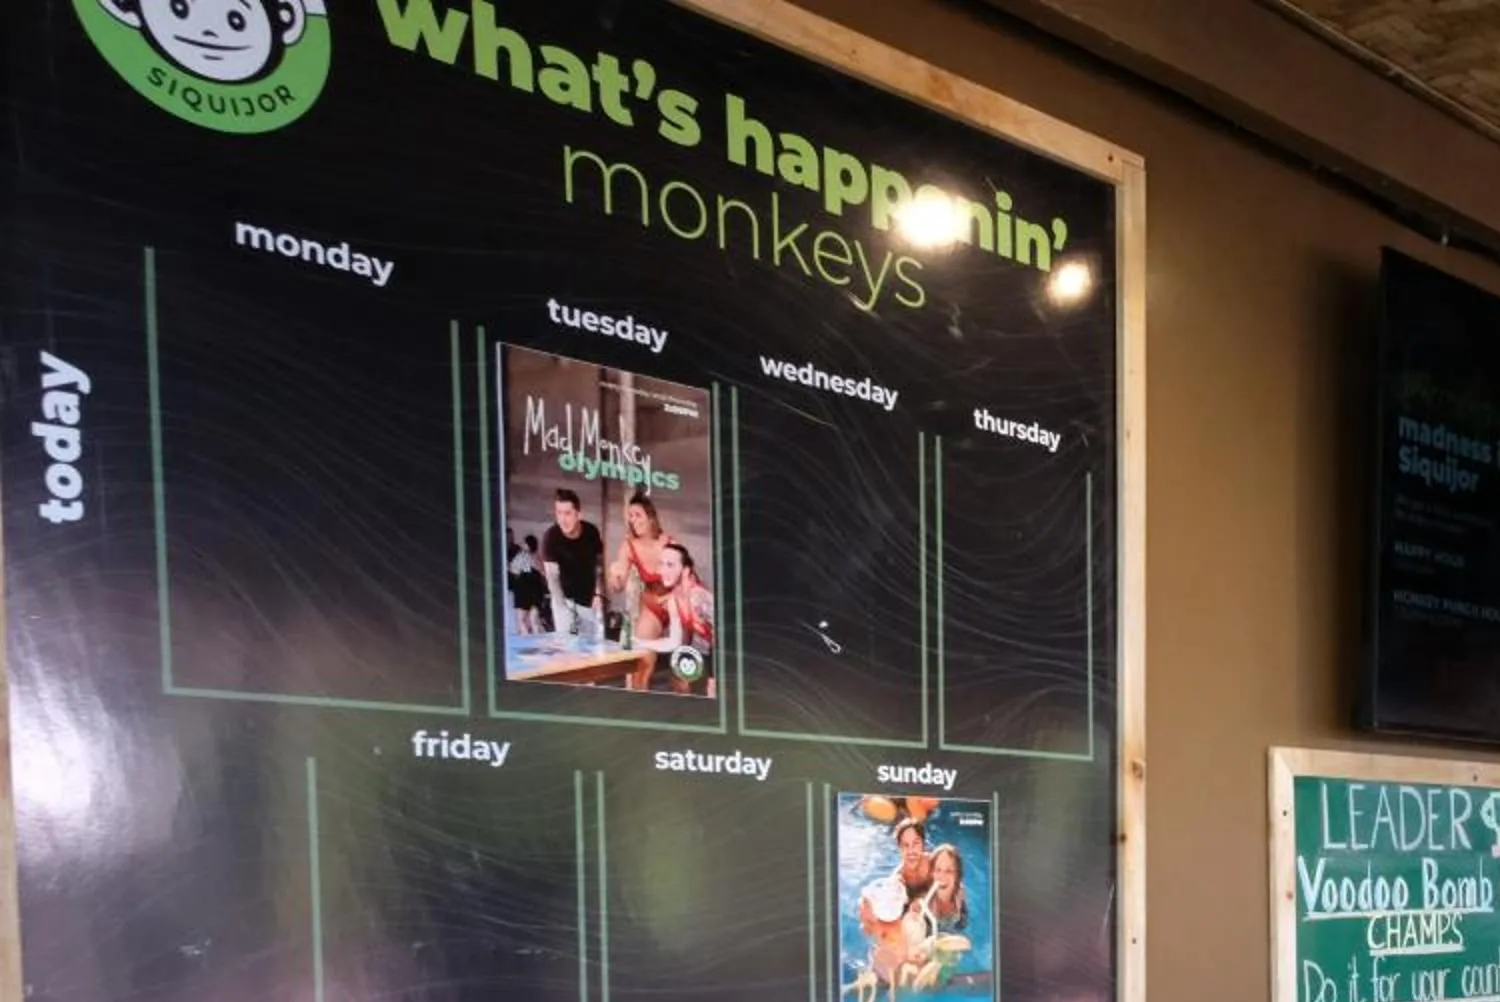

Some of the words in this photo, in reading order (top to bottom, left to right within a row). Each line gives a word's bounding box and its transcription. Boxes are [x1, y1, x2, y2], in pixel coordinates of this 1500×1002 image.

[146, 65, 296, 117] SIQUIJOR
[377, 0, 702, 147] what's
[726, 93, 1068, 271] happnin'
[235, 220, 394, 286] monday
[563, 145, 926, 311] monkeys
[547, 298, 668, 353] tuesday
[760, 356, 898, 410] wednesday
[31, 351, 91, 524] today
[524, 395, 573, 455] Mad
[579, 406, 652, 496] Monkey
[973, 408, 1061, 452] thursday
[1399, 416, 1493, 464] madness
[558, 452, 680, 490] olympics
[1398, 446, 1480, 493] Siquijor
[411, 731, 511, 768] friday
[654, 748, 772, 783] saturday
[877, 763, 957, 790] sunday
[1320, 783, 1472, 851] LEADER
[1298, 856, 1410, 912] Voodoo
[1422, 858, 1493, 909] Bomb
[1367, 911, 1464, 949] CHAMPS
